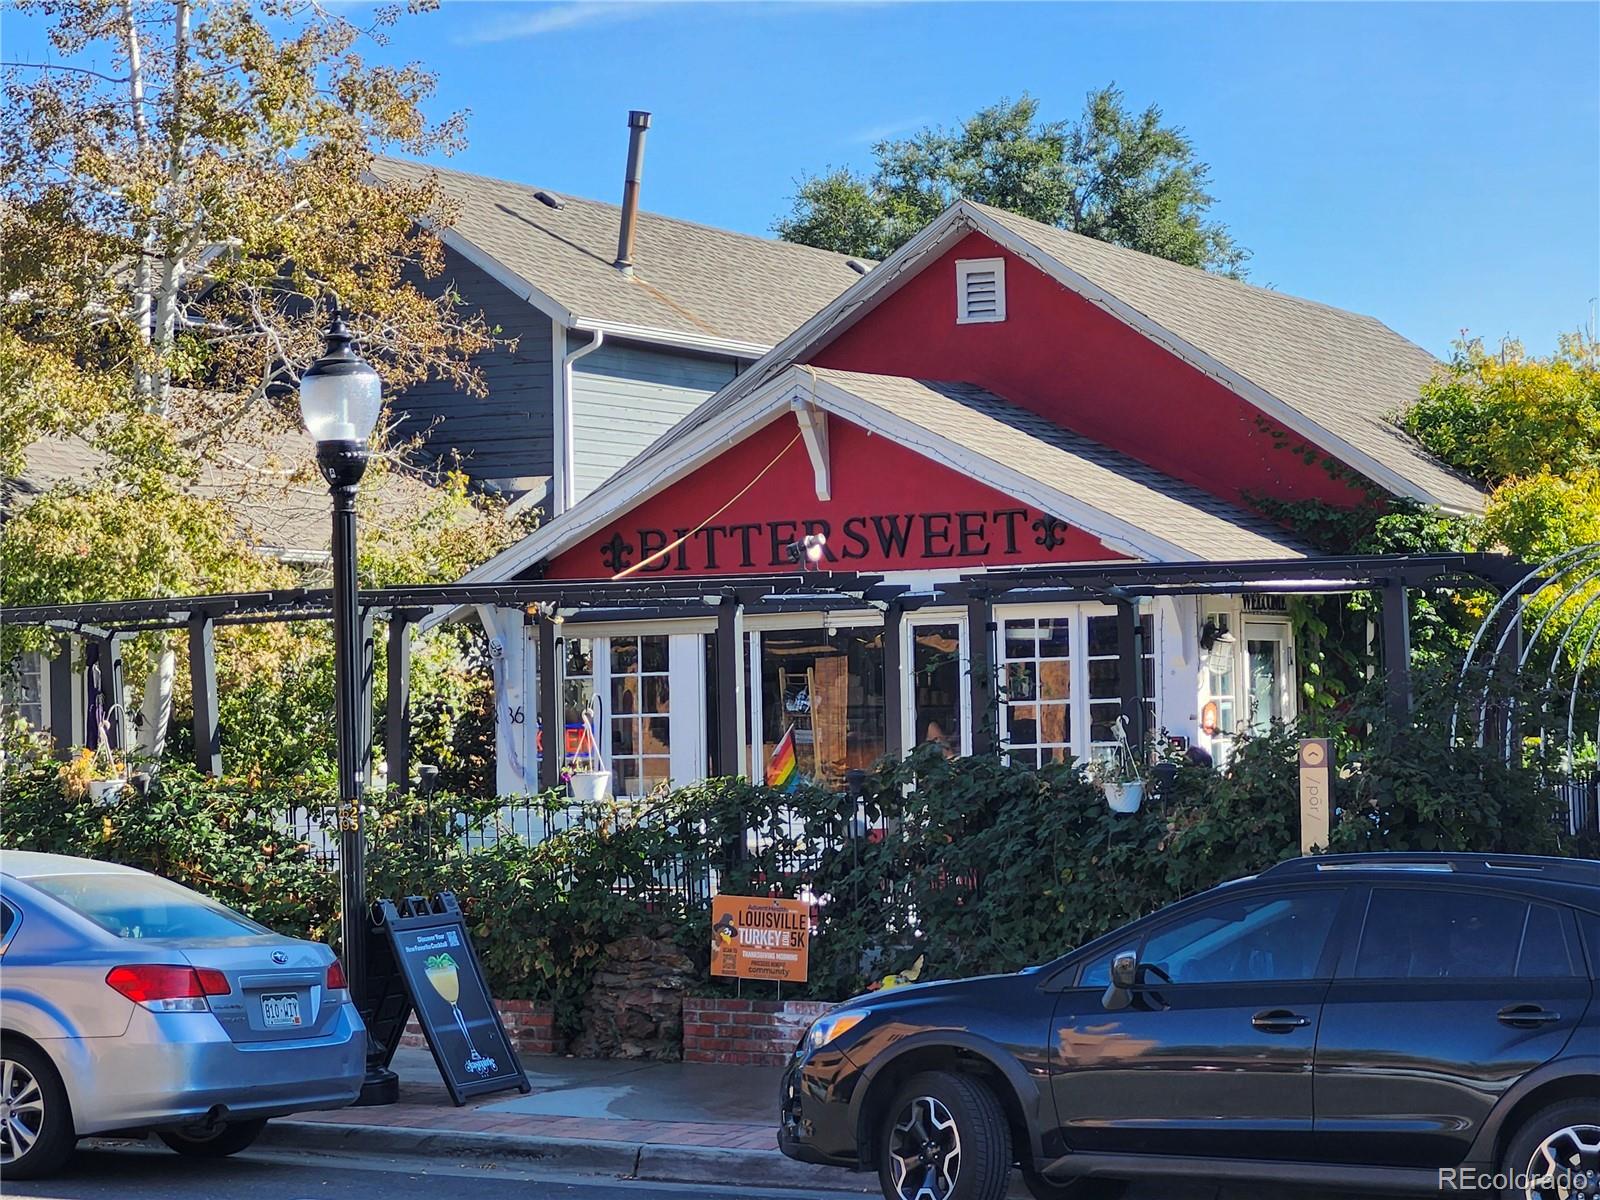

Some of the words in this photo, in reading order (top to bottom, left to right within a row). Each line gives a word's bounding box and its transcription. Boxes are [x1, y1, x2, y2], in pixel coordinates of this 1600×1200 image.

[637, 507, 1028, 573] BITTERSWEET
[738, 910, 807, 930] LOUISVILLE
[738, 927, 783, 947] TURKEY
[790, 931, 805, 948] 5K
[748, 966, 789, 977] community
